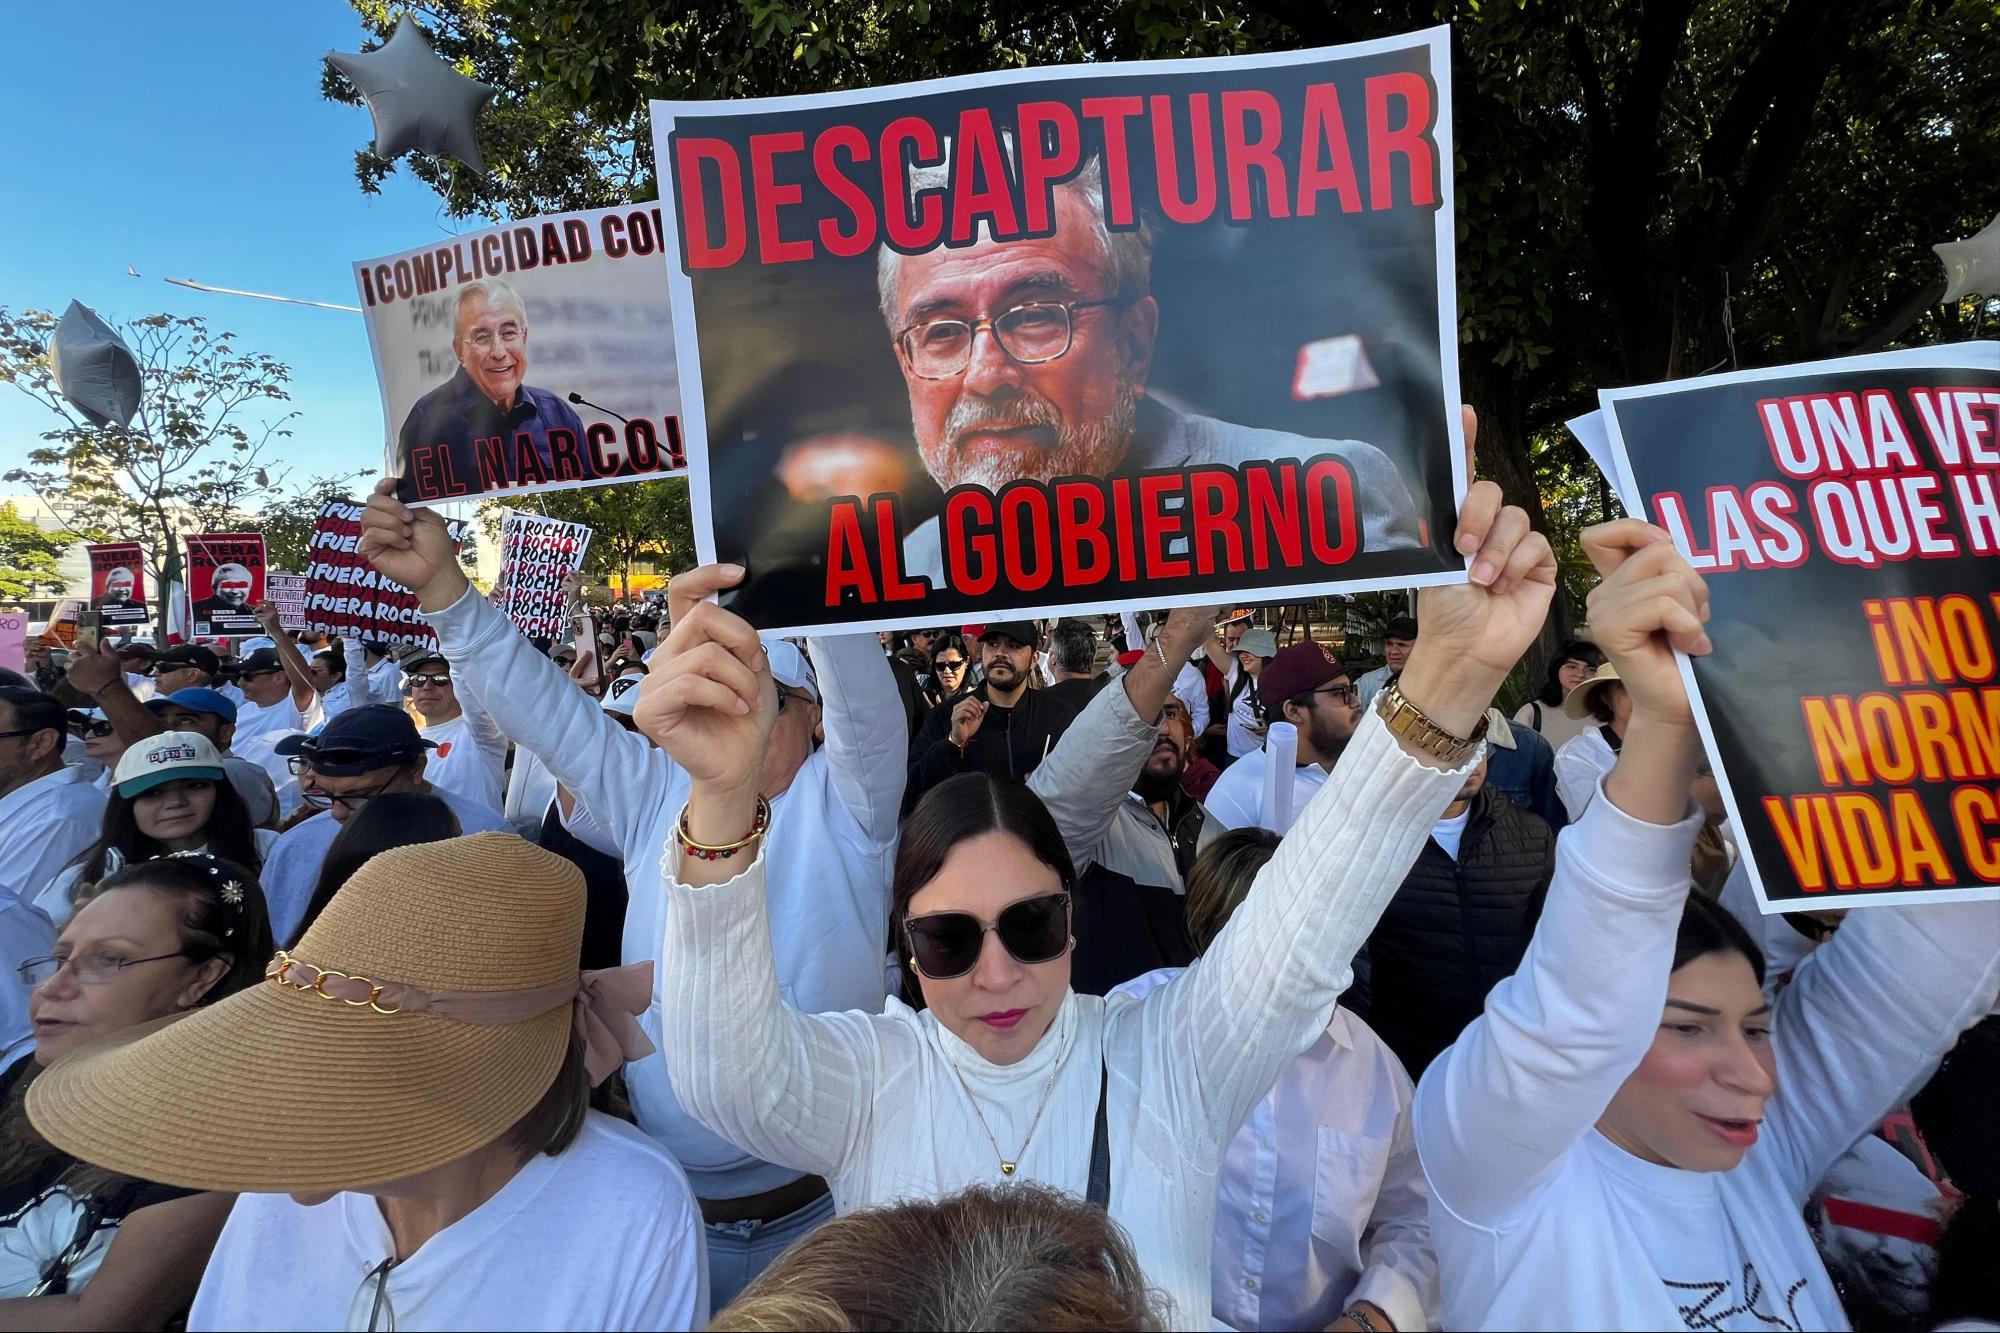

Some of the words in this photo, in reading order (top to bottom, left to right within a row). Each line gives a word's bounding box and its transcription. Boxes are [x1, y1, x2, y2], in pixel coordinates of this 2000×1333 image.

[675, 72, 1437, 269] DESCAPTURAR
[361, 218, 593, 306] ¡COMPLICIDAD
[411, 443, 467, 500] EL
[474, 415, 688, 491] NARCO!
[1761, 392, 1918, 475] UNA
[310, 529, 363, 553] ¡FUE
[519, 546, 578, 567] ROCHA!
[522, 534, 581, 555] ROCHA!
[523, 520, 583, 542] ROCHA!
[825, 501, 925, 607] AL
[945, 460, 1359, 597] GOBIERNO
[1657, 484, 1804, 569] LAS
[1812, 475, 1956, 563] QUE
[304, 591, 374, 617] ¡FUERA
[306, 560, 377, 588] ¡FUERA
[1865, 595, 1995, 684] ¡NO
[1765, 789, 1954, 889] VIDA
